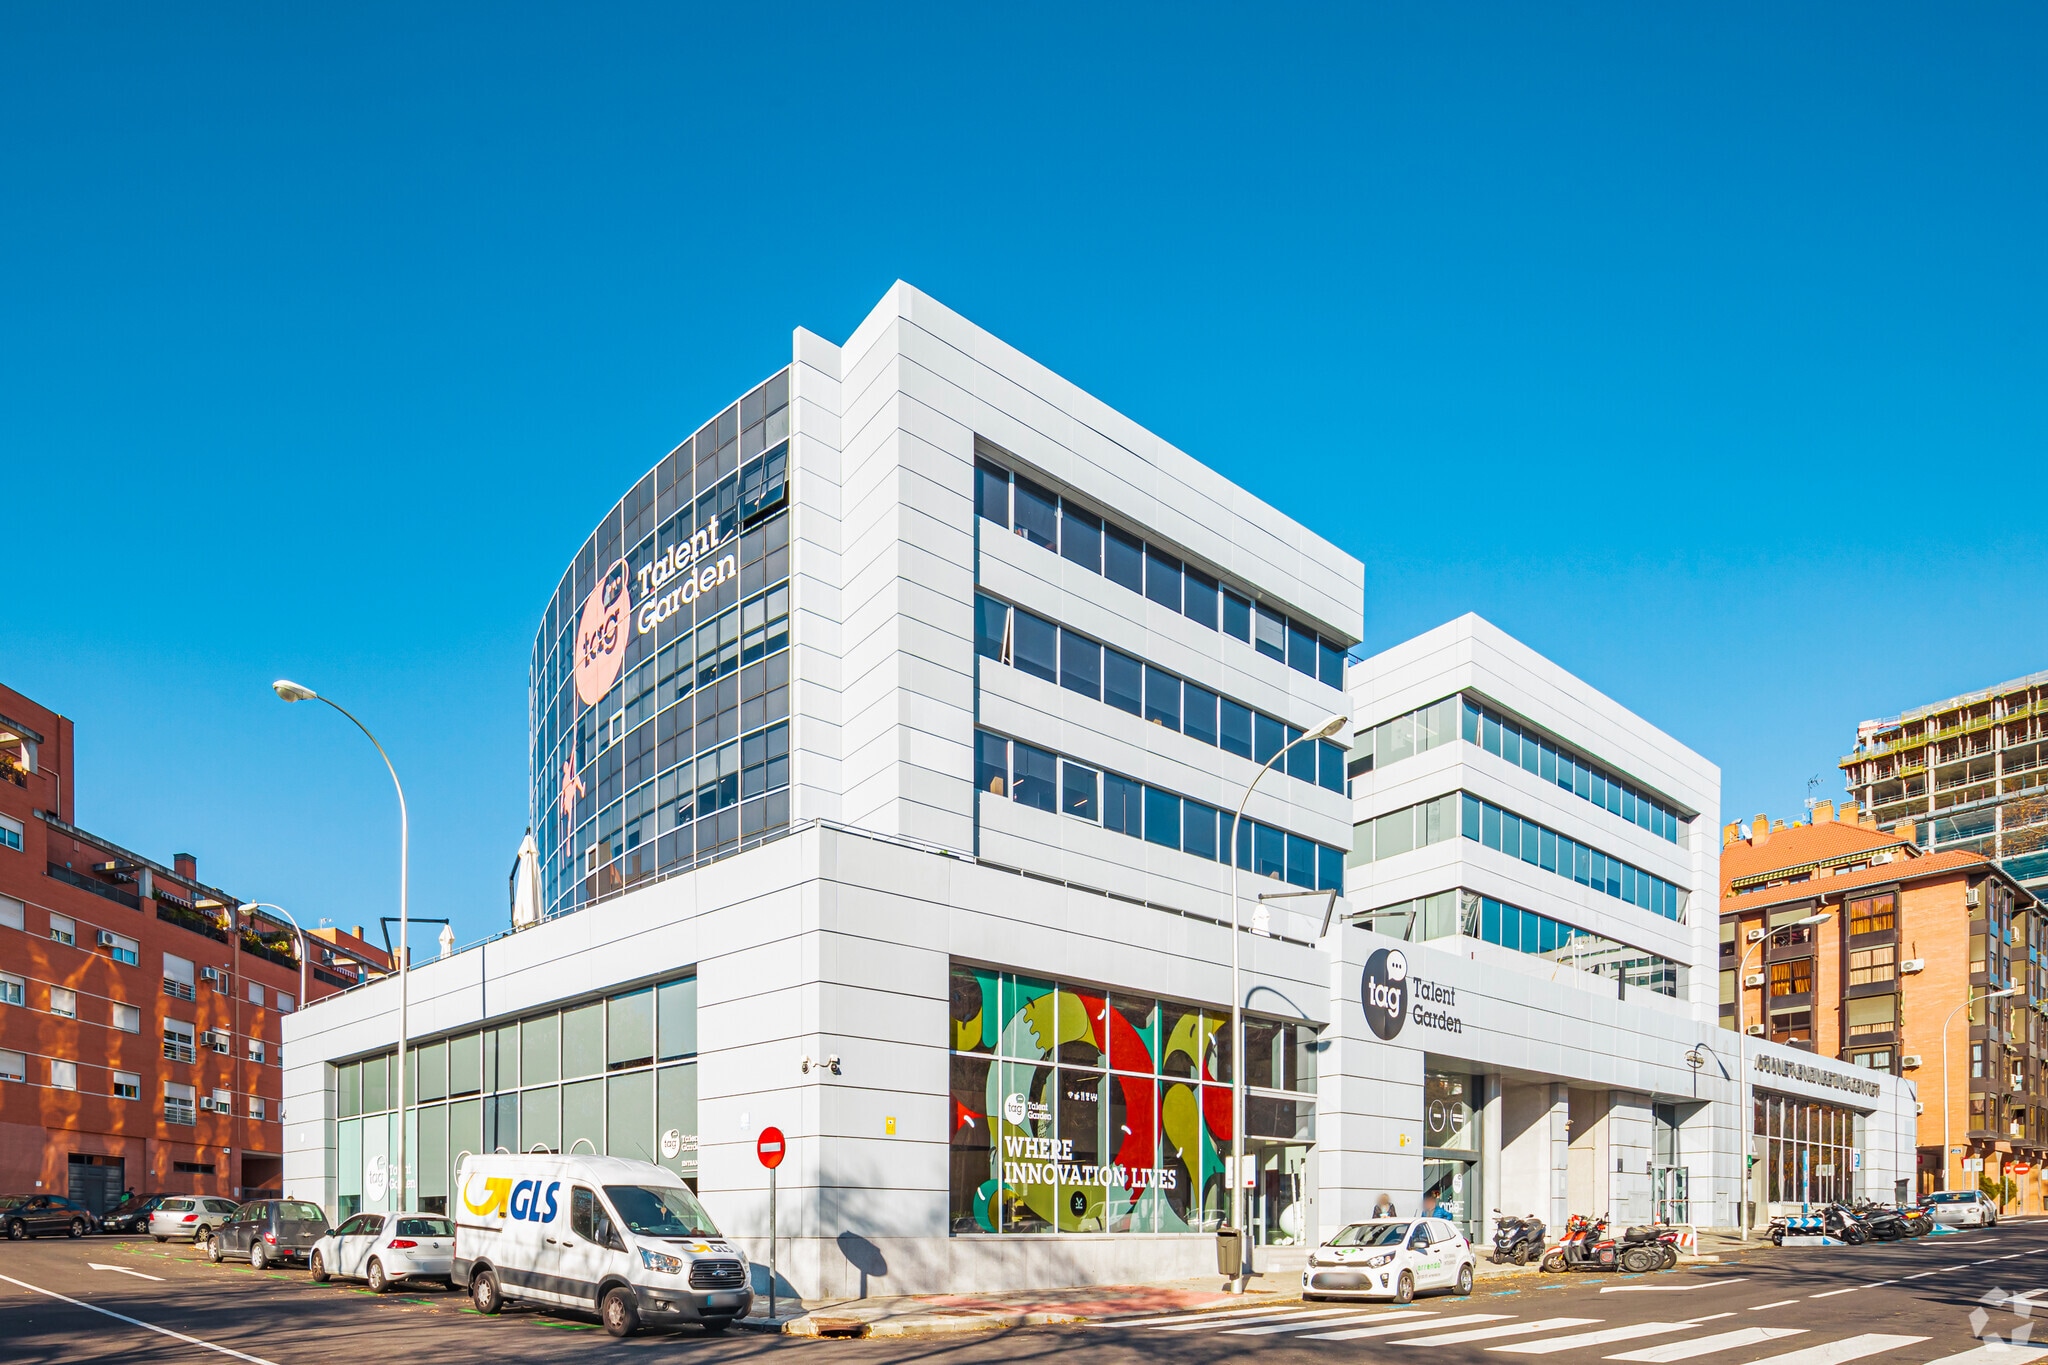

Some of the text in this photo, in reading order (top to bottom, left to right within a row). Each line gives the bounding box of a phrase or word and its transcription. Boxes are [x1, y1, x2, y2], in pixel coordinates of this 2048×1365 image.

[637, 514, 719, 599] Talent
[637, 554, 737, 635] Garden
[583, 608, 620, 669] tag
[1368, 975, 1401, 1018] tag
[1413, 977, 1456, 1007] Talent
[1413, 1004, 1462, 1034] Garden
[1008, 1102, 1023, 1116] tag
[1027, 1101, 1049, 1111] Talent
[1027, 1110, 1052, 1121] Garden
[664, 1140, 676, 1149] tag
[1004, 1135, 1073, 1161] WHERE
[369, 1170, 384, 1187] tag
[1004, 1161, 1177, 1189] INNOVATION LIVES
[510, 1179, 561, 1224] GLS
[710, 1244, 735, 1253] GLS
